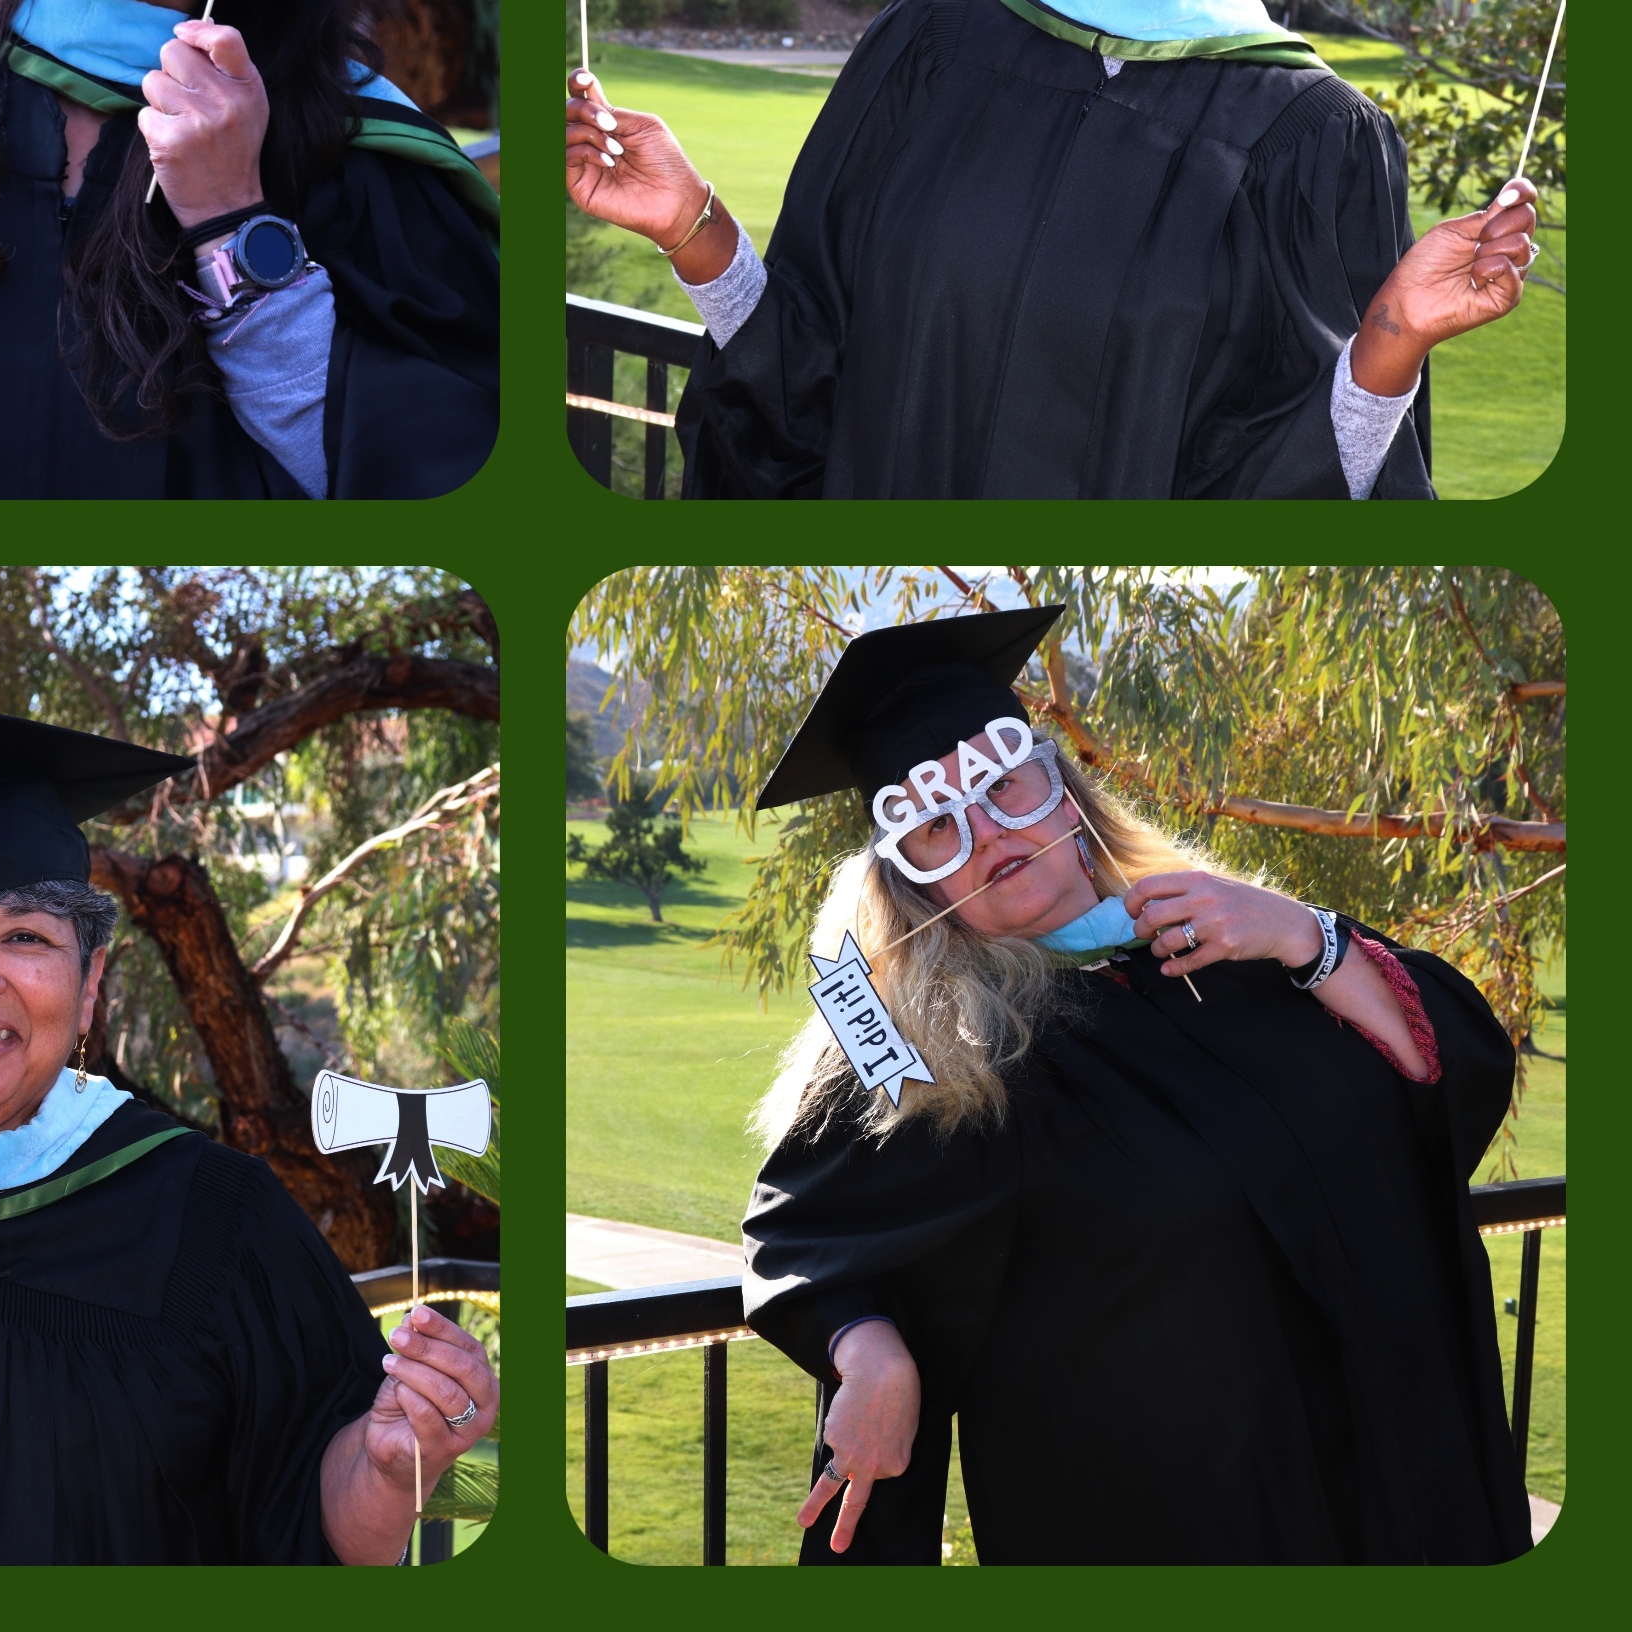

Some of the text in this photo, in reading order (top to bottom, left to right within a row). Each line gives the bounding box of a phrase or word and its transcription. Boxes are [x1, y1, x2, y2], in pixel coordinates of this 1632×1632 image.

[872, 716, 1033, 833] GRAD
[1323, 946, 1335, 972] child
[1327, 932, 1335, 943] of
[821, 973, 899, 1077] I did it!
